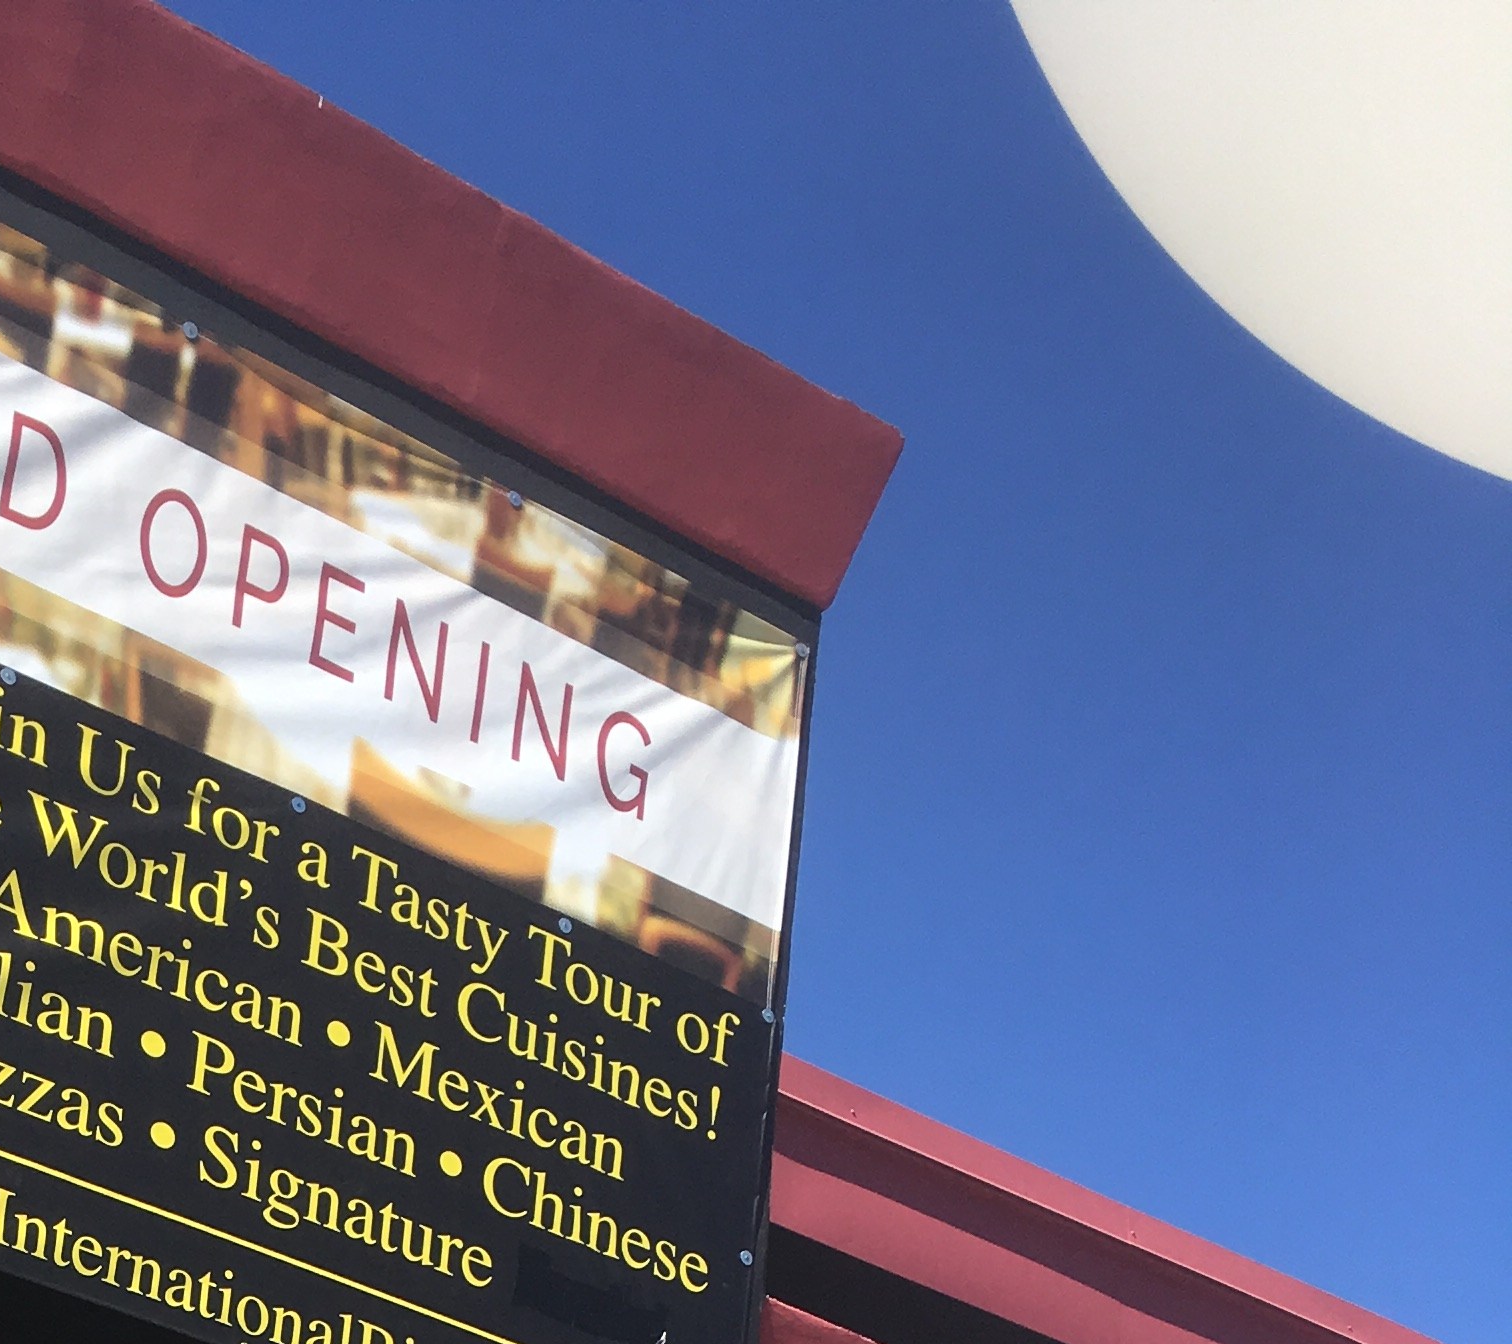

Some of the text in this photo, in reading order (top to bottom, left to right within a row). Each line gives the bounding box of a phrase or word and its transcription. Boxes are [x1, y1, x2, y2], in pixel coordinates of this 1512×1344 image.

[141, 492, 649, 818] OPENING
[30, 792, 279, 949] World's
[304, 909, 436, 1017] Best
[458, 983, 720, 1140] Cuisines!
[80, 725, 160, 814] Us
[186, 778, 280, 861] for
[298, 842, 328, 888] a
[352, 846, 508, 974] Tasty
[529, 926, 660, 1030] Tour
[677, 1013, 740, 1064] of
[189, 1032, 414, 1176] Persian
[483, 1158, 708, 1292] Chinese
[200, 1126, 492, 1287] Signature
[372, 1022, 622, 1179] Mexican
